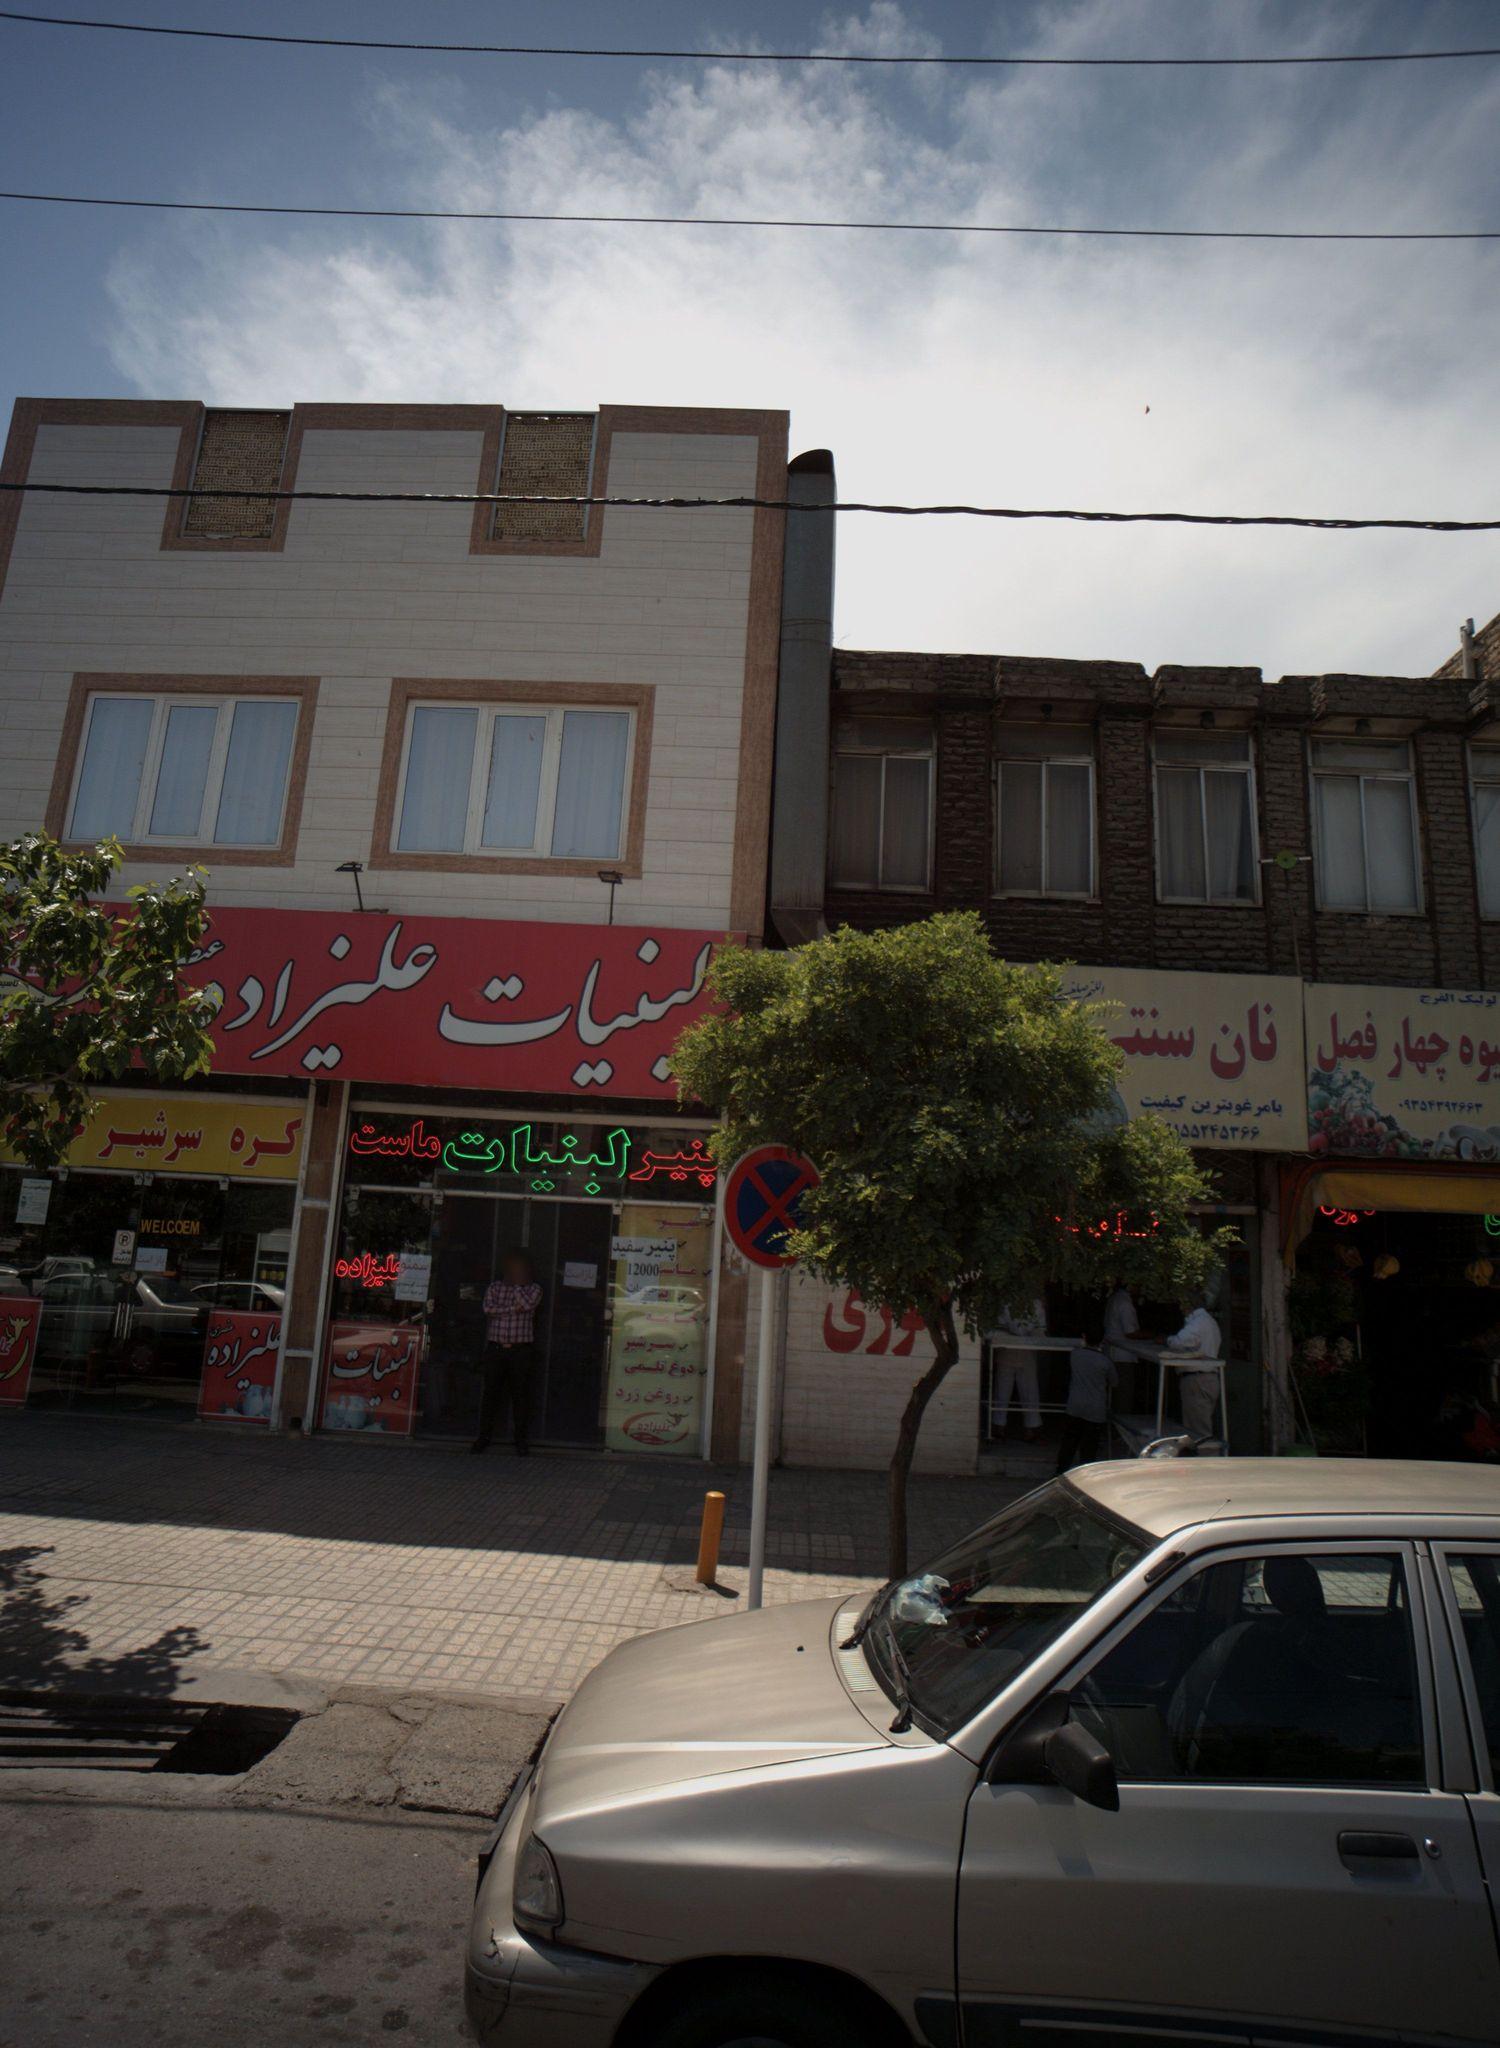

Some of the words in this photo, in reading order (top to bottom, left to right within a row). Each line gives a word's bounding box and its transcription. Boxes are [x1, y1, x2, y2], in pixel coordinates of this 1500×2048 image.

[437, 941, 713, 1088] لبنیات
[1210, 1002, 1277, 1079] نان
[1317, 1010, 1377, 1073] فصل
[1387, 1015, 1449, 1082] چهار
[1459, 1034, 1500, 1083] یوه
[1140, 1095, 1186, 1112] کیفیت
[97, 1110, 204, 1162] سرشیر
[229, 1118, 304, 1168] کره
[350, 1119, 441, 1160] ماست
[628, 1138, 719, 1189] پنیر
[612, 1239, 644, 1257] سفید
[628, 1263, 659, 1276] 12000
[332, 1335, 414, 1407] لبنیات
[669, 1359, 695, 1377] دوغ
[616, 1388, 640, 1402] زرد
[644, 1387, 679, 1405] روغن
